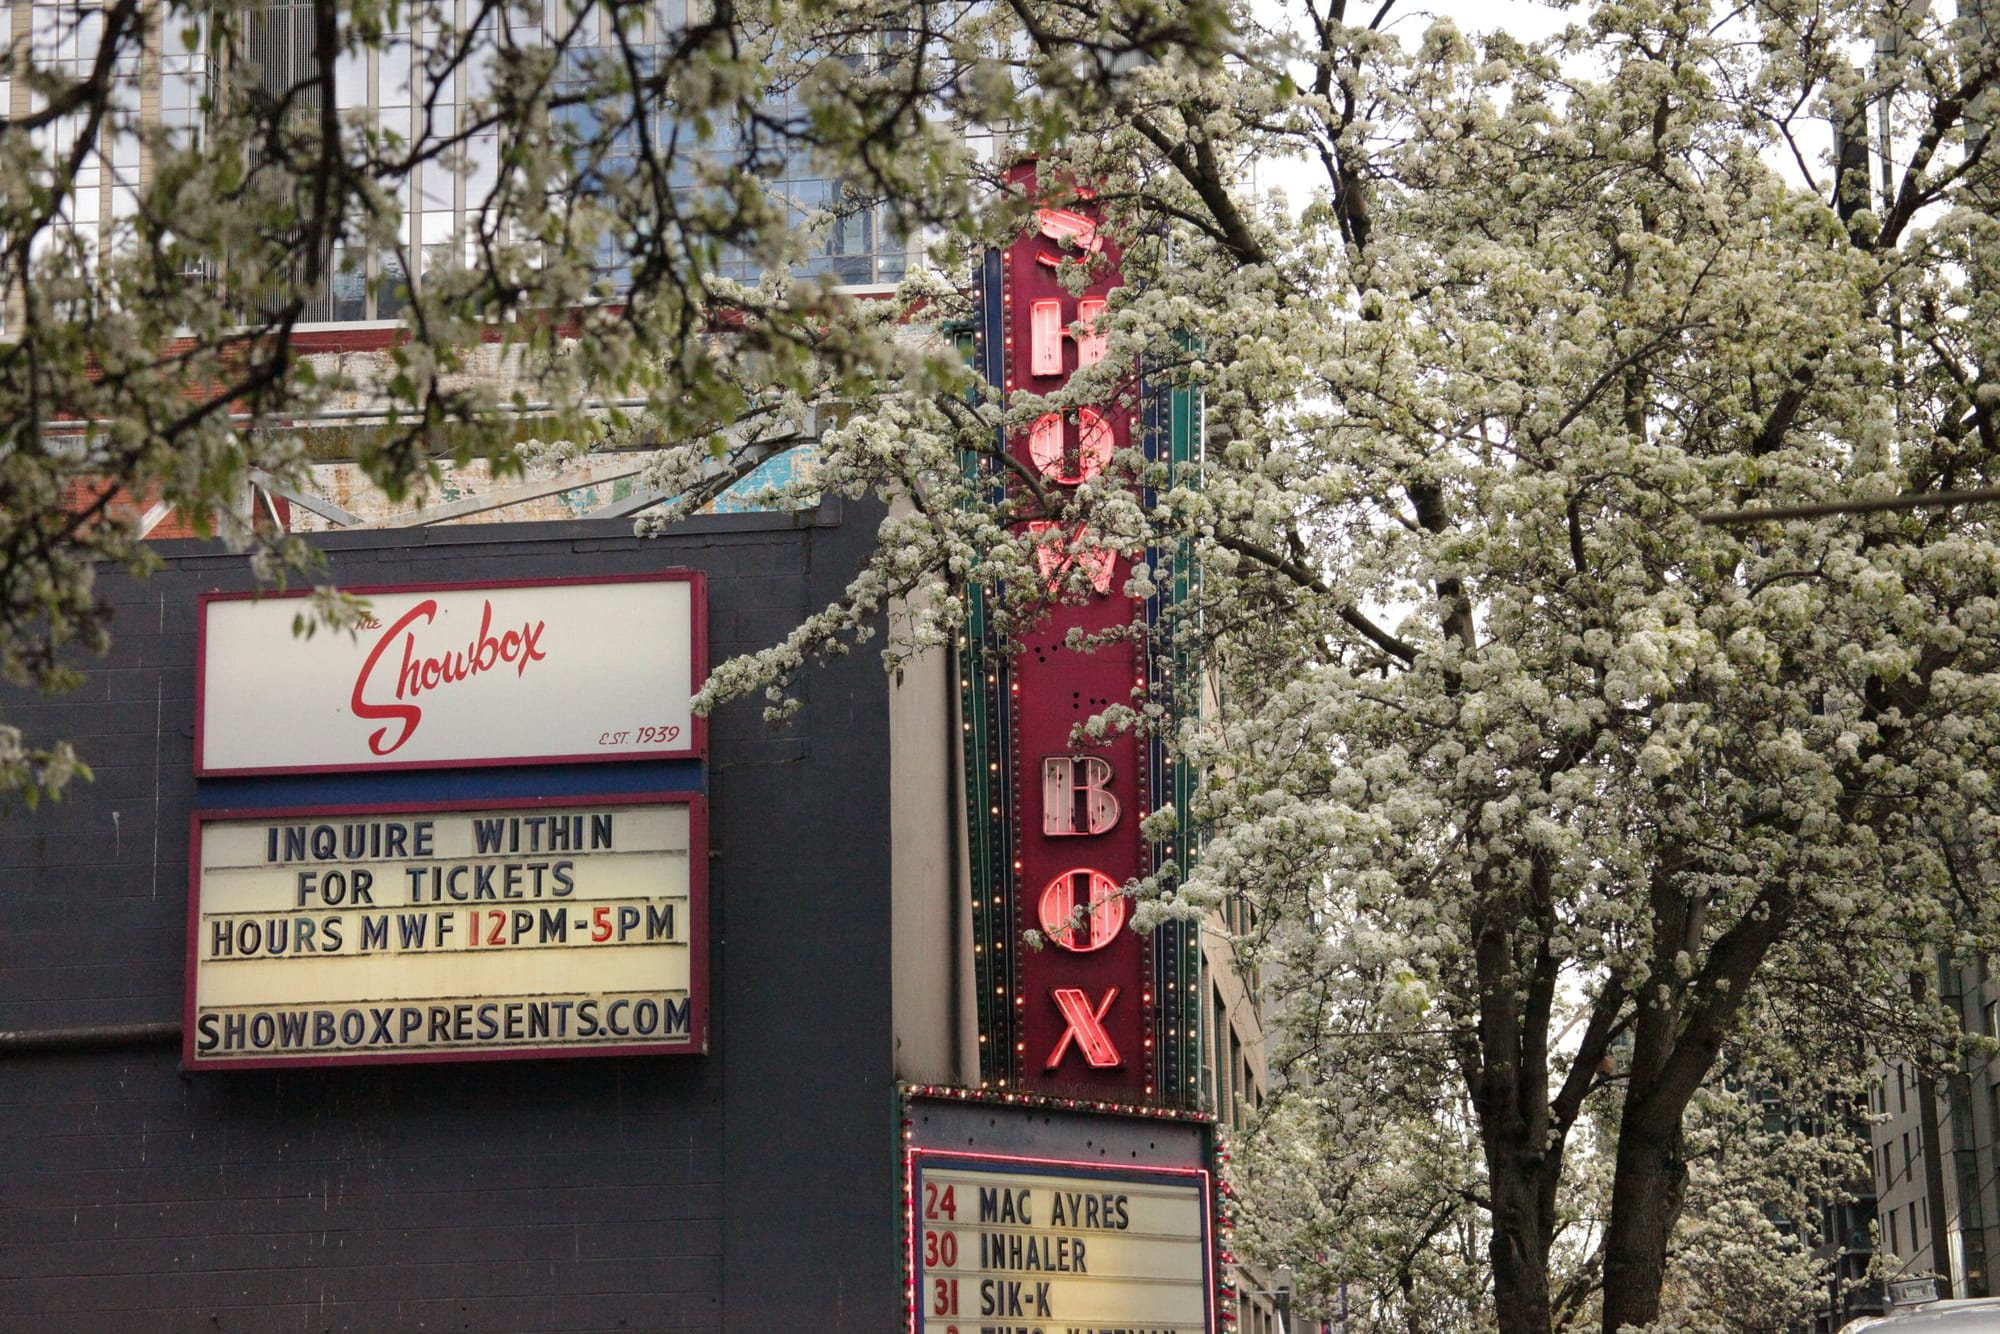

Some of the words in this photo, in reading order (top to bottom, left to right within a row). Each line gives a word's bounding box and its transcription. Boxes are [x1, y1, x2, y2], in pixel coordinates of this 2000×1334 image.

[351, 599, 546, 756] Showbox
[599, 731, 630, 745] EST.
[636, 726, 680, 743] 1939
[267, 821, 434, 862] INQUIRE
[474, 814, 613, 854] WITHIN
[299, 869, 373, 906] FOR
[406, 861, 574, 901] TICKETS
[211, 916, 343, 956] HOURS
[360, 912, 455, 950] MWF
[468, 904, 674, 946] 12PM-5PM
[198, 998, 690, 1050] SHOWBOXPRESENTS.COM
[925, 1183, 956, 1220] 24
[979, 1187, 1031, 1225] MAC
[1051, 1191, 1129, 1230] AYRES
[925, 1231, 957, 1267] 30
[981, 1233, 1087, 1272] INHALER
[934, 1279, 958, 1316] 31
[980, 1279, 1051, 1317] SIK-K
